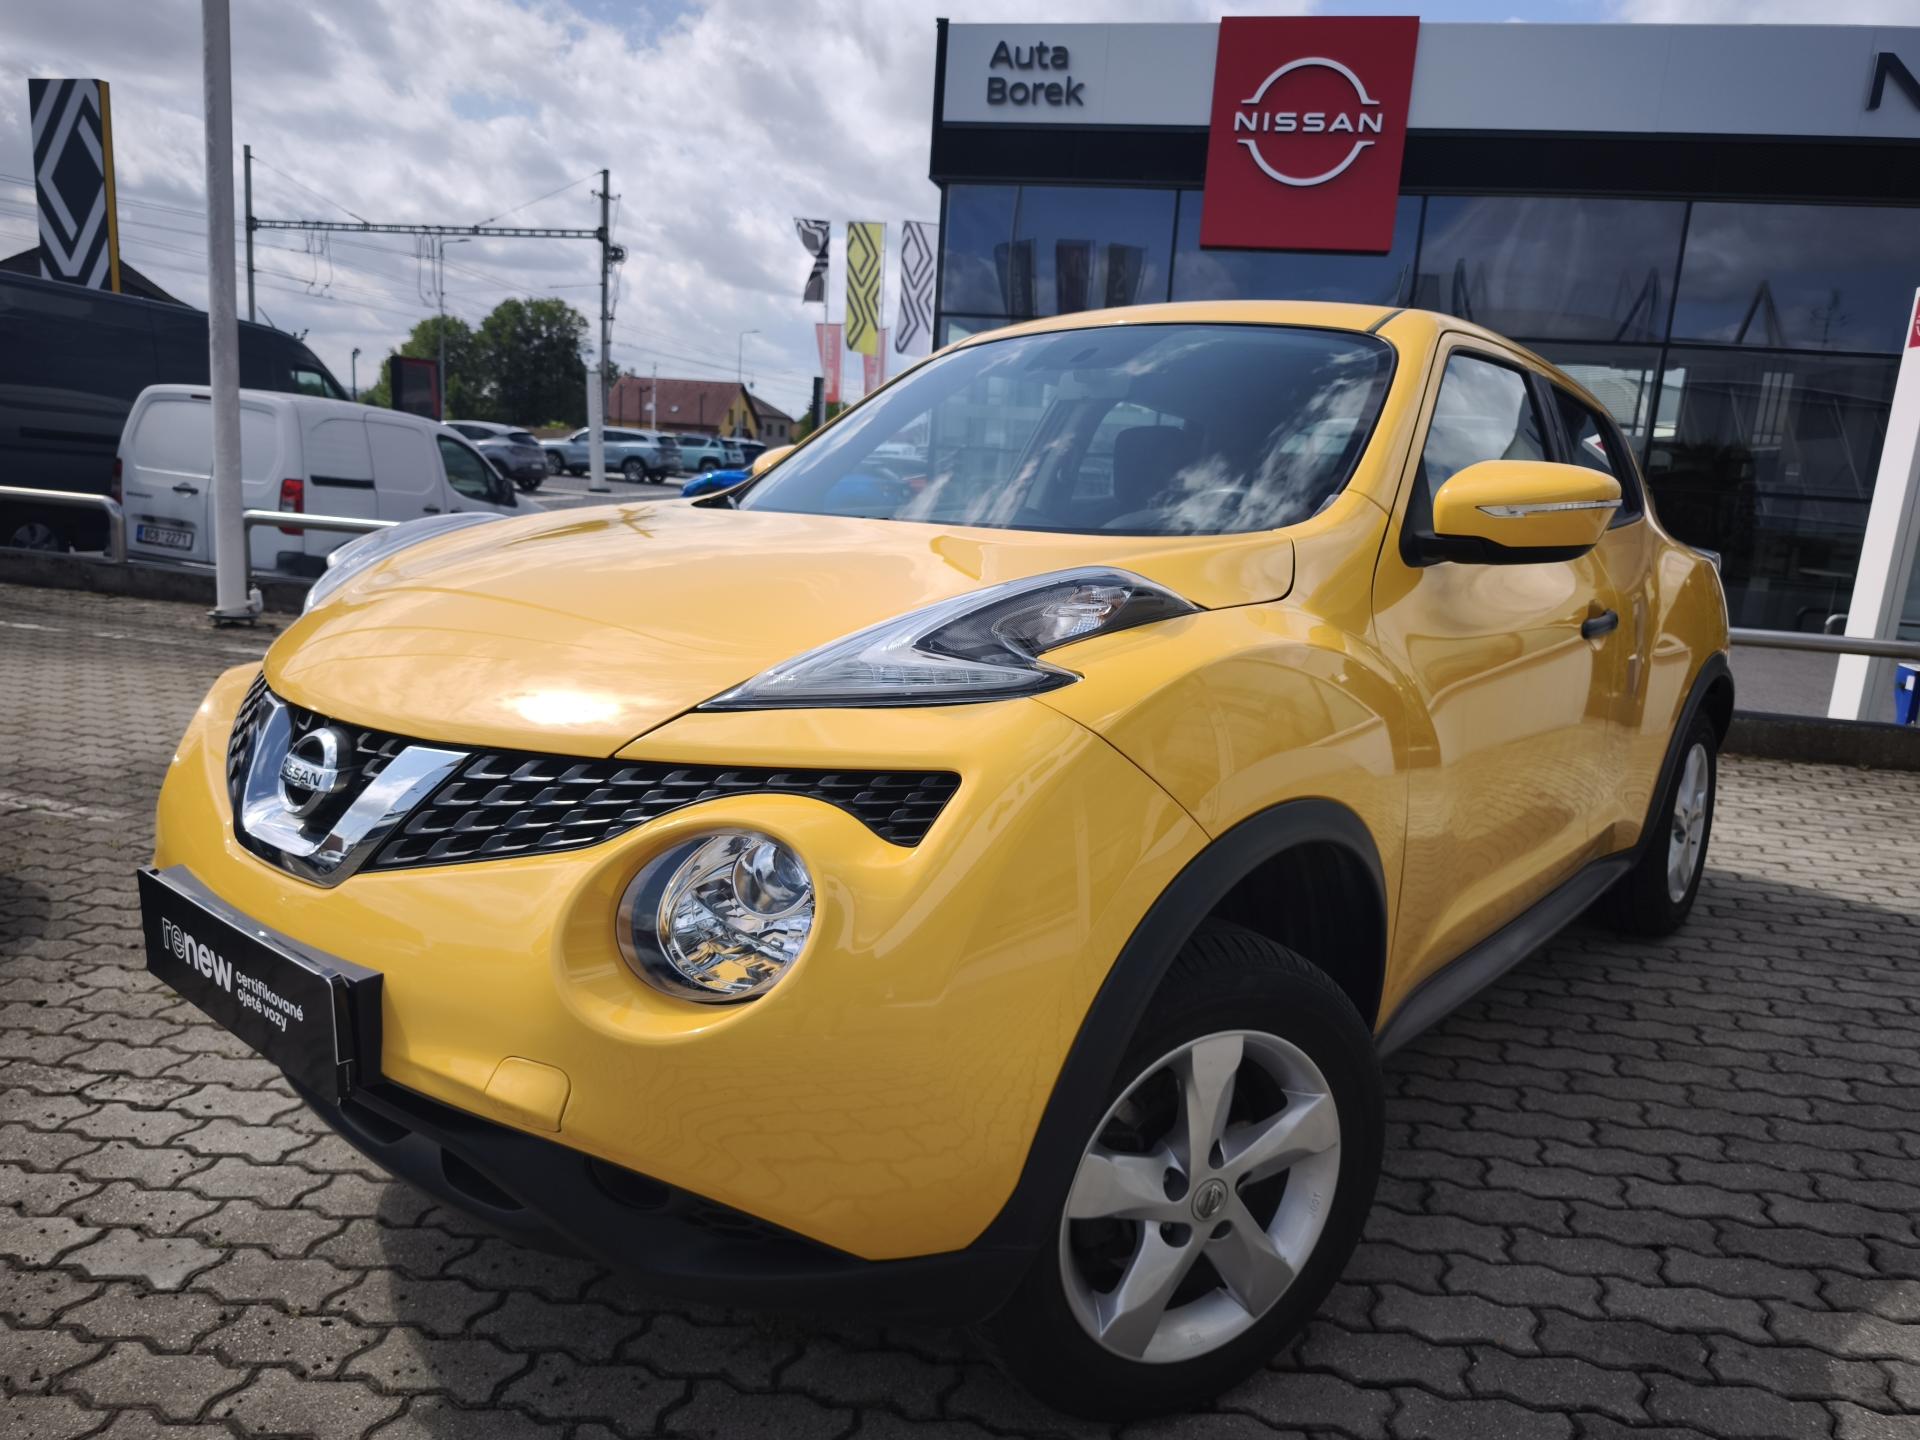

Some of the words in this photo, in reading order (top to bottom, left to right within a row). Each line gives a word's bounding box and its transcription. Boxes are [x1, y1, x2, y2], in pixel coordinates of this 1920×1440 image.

[989, 40, 1069, 70] Auta
[987, 75, 1085, 107] Borek
[1233, 111, 1384, 133] NISSAN
[282, 758, 323, 787] NISSAN
[162, 918, 232, 992] renew
[235, 971, 304, 1021] certifikované
[237, 988, 262, 1013] ojeté
[264, 1008, 287, 1032] vozy
